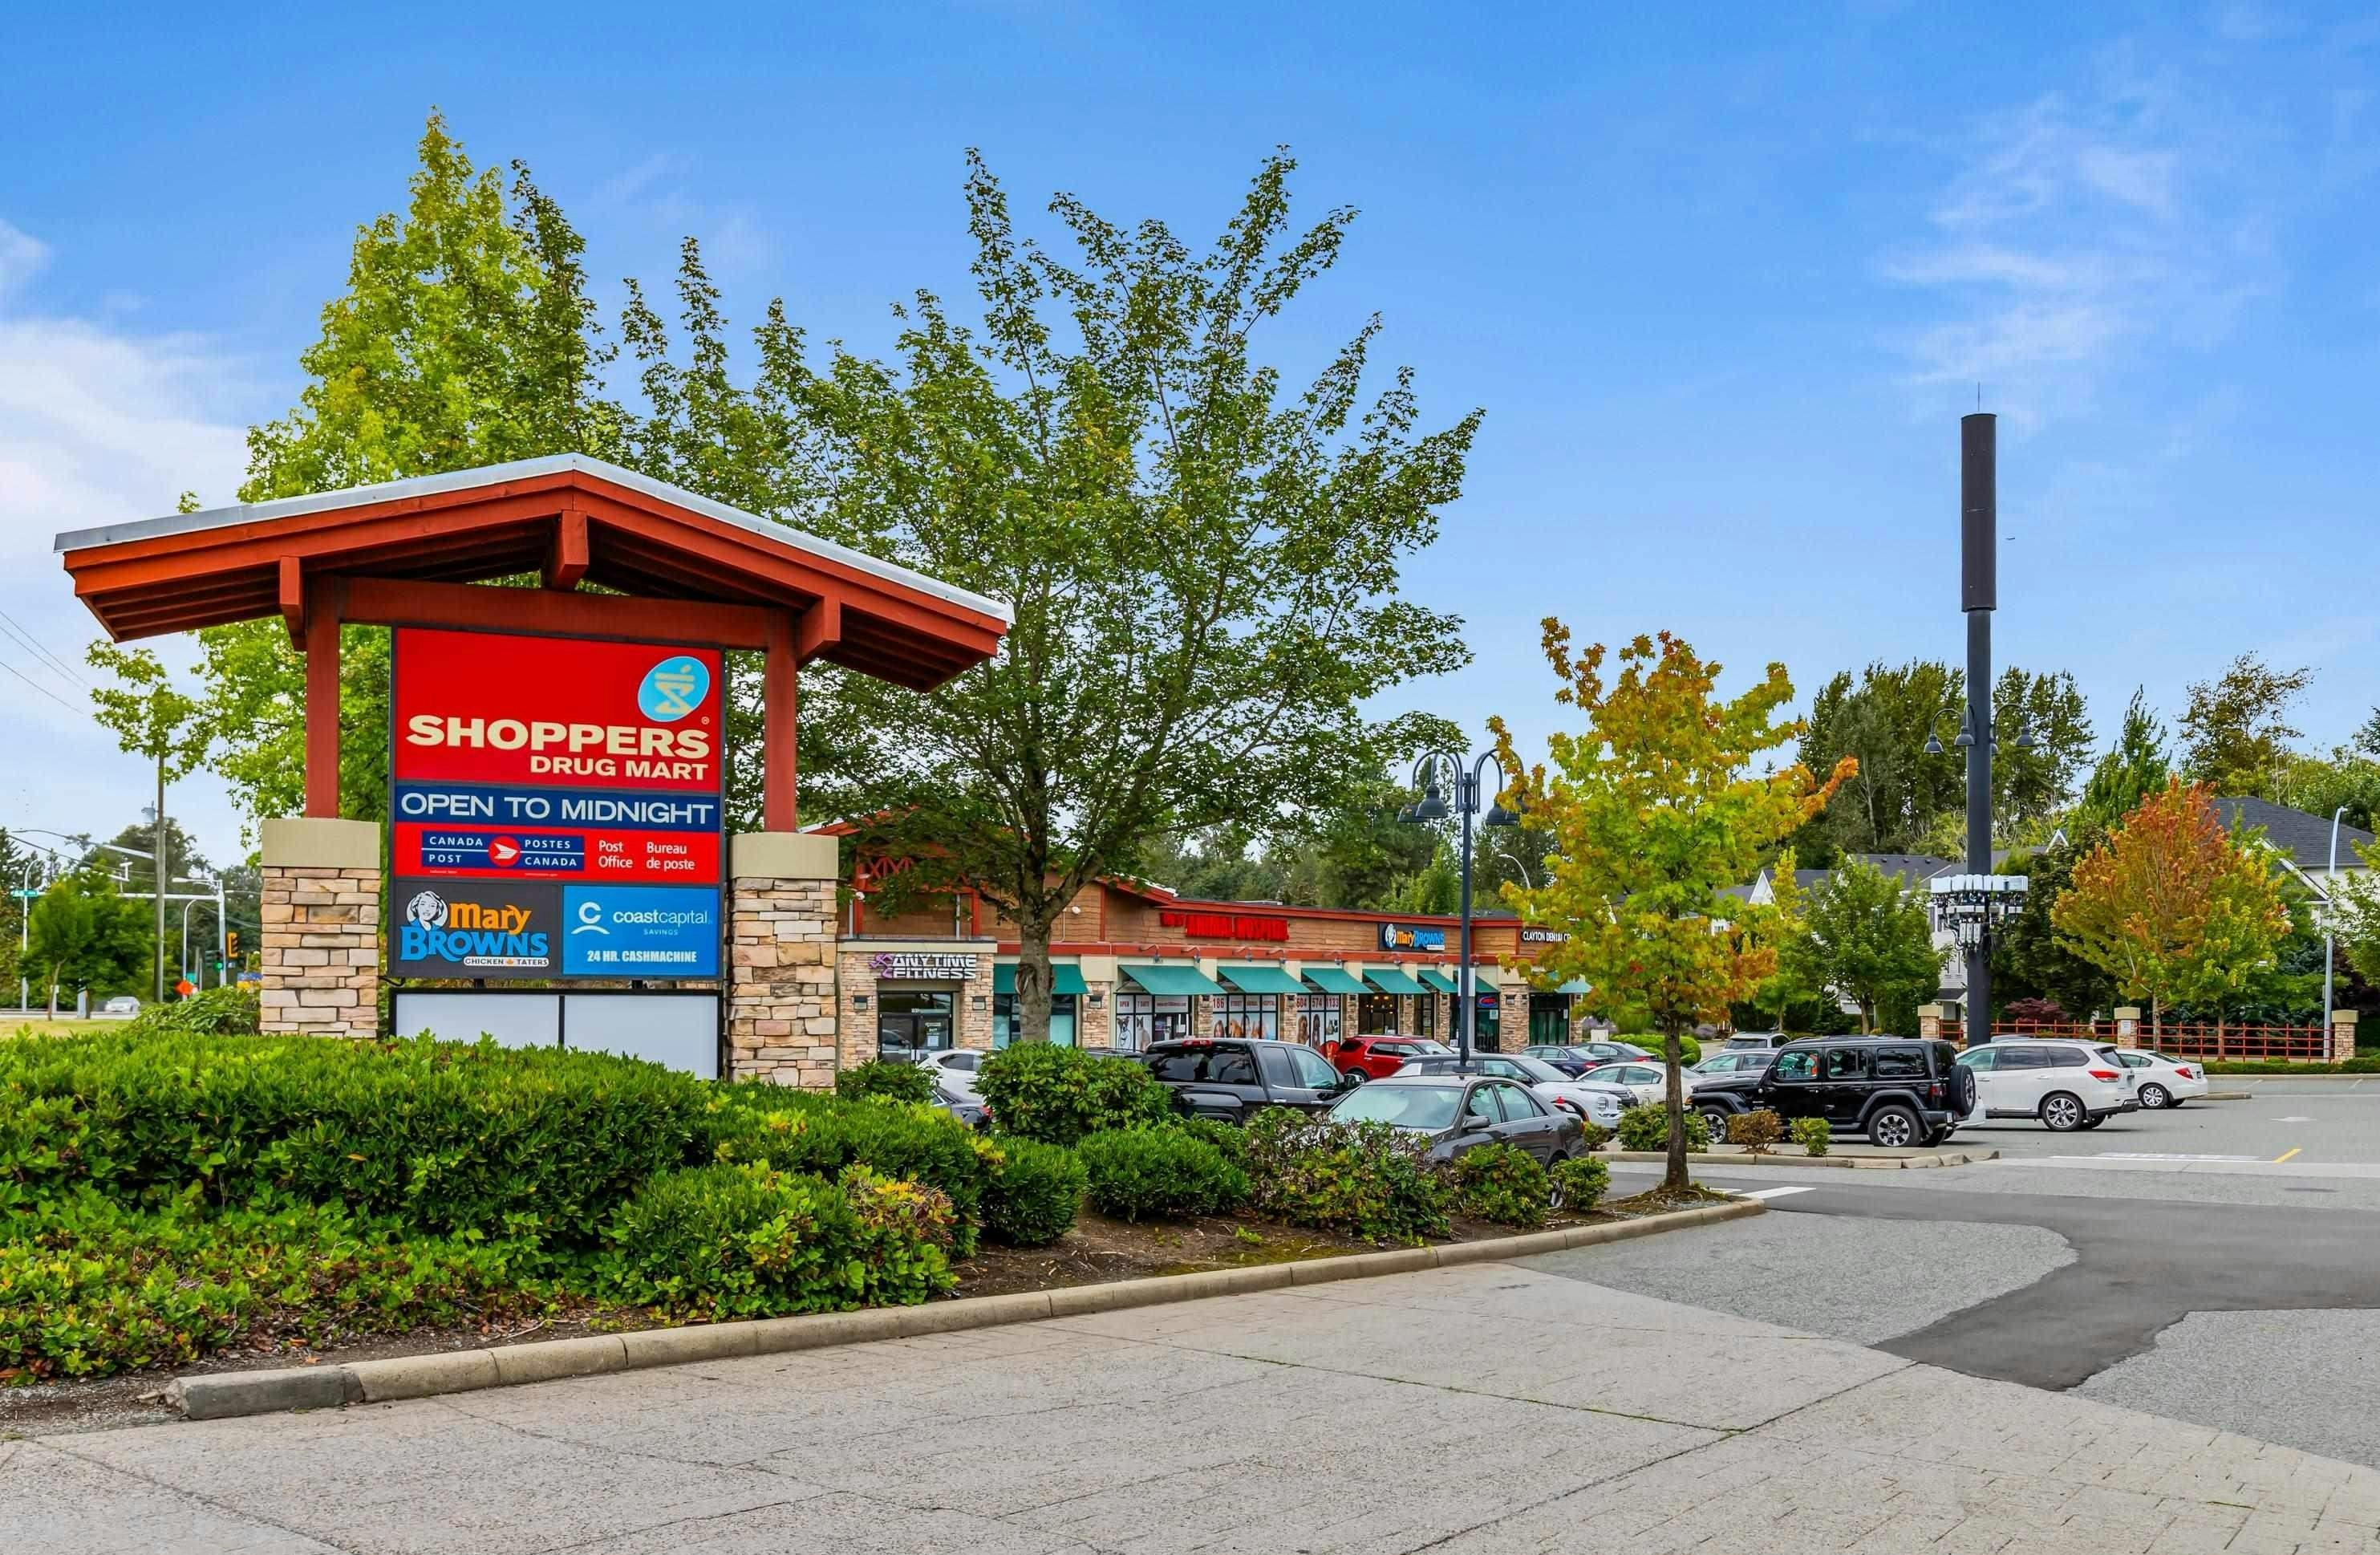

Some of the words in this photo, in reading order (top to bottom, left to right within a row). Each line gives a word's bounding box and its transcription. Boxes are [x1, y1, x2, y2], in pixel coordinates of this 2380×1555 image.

[406, 715, 710, 759] SHOPPERS
[530, 756, 616, 777] DRUG
[625, 761, 709, 781] MART
[401, 792, 493, 818] OPEN
[504, 797, 550, 819] TO
[562, 799, 714, 825] MIDNIGHT
[429, 836, 483, 847] CANADA
[525, 839, 570, 849] POSTES
[598, 840, 623, 852] Post
[647, 842, 687, 854] Bureau
[429, 854, 461, 863] POST
[525, 857, 577, 867] CANADA
[598, 855, 633, 867] Office
[647, 856, 661, 869] de
[663, 859, 695, 871] poste
[449, 903, 533, 935] mary
[1522, 931, 1545, 941] CLAYTON
[399, 925, 549, 961] BROWNS
[464, 957, 504, 965] CHICKEN
[587, 950, 601, 962] 24
[602, 950, 620, 962] HR.
[622, 950, 697, 963] CASHMACHINE
[892, 953, 976, 968] ANYTIME
[892, 968, 976, 979] FITNESS
